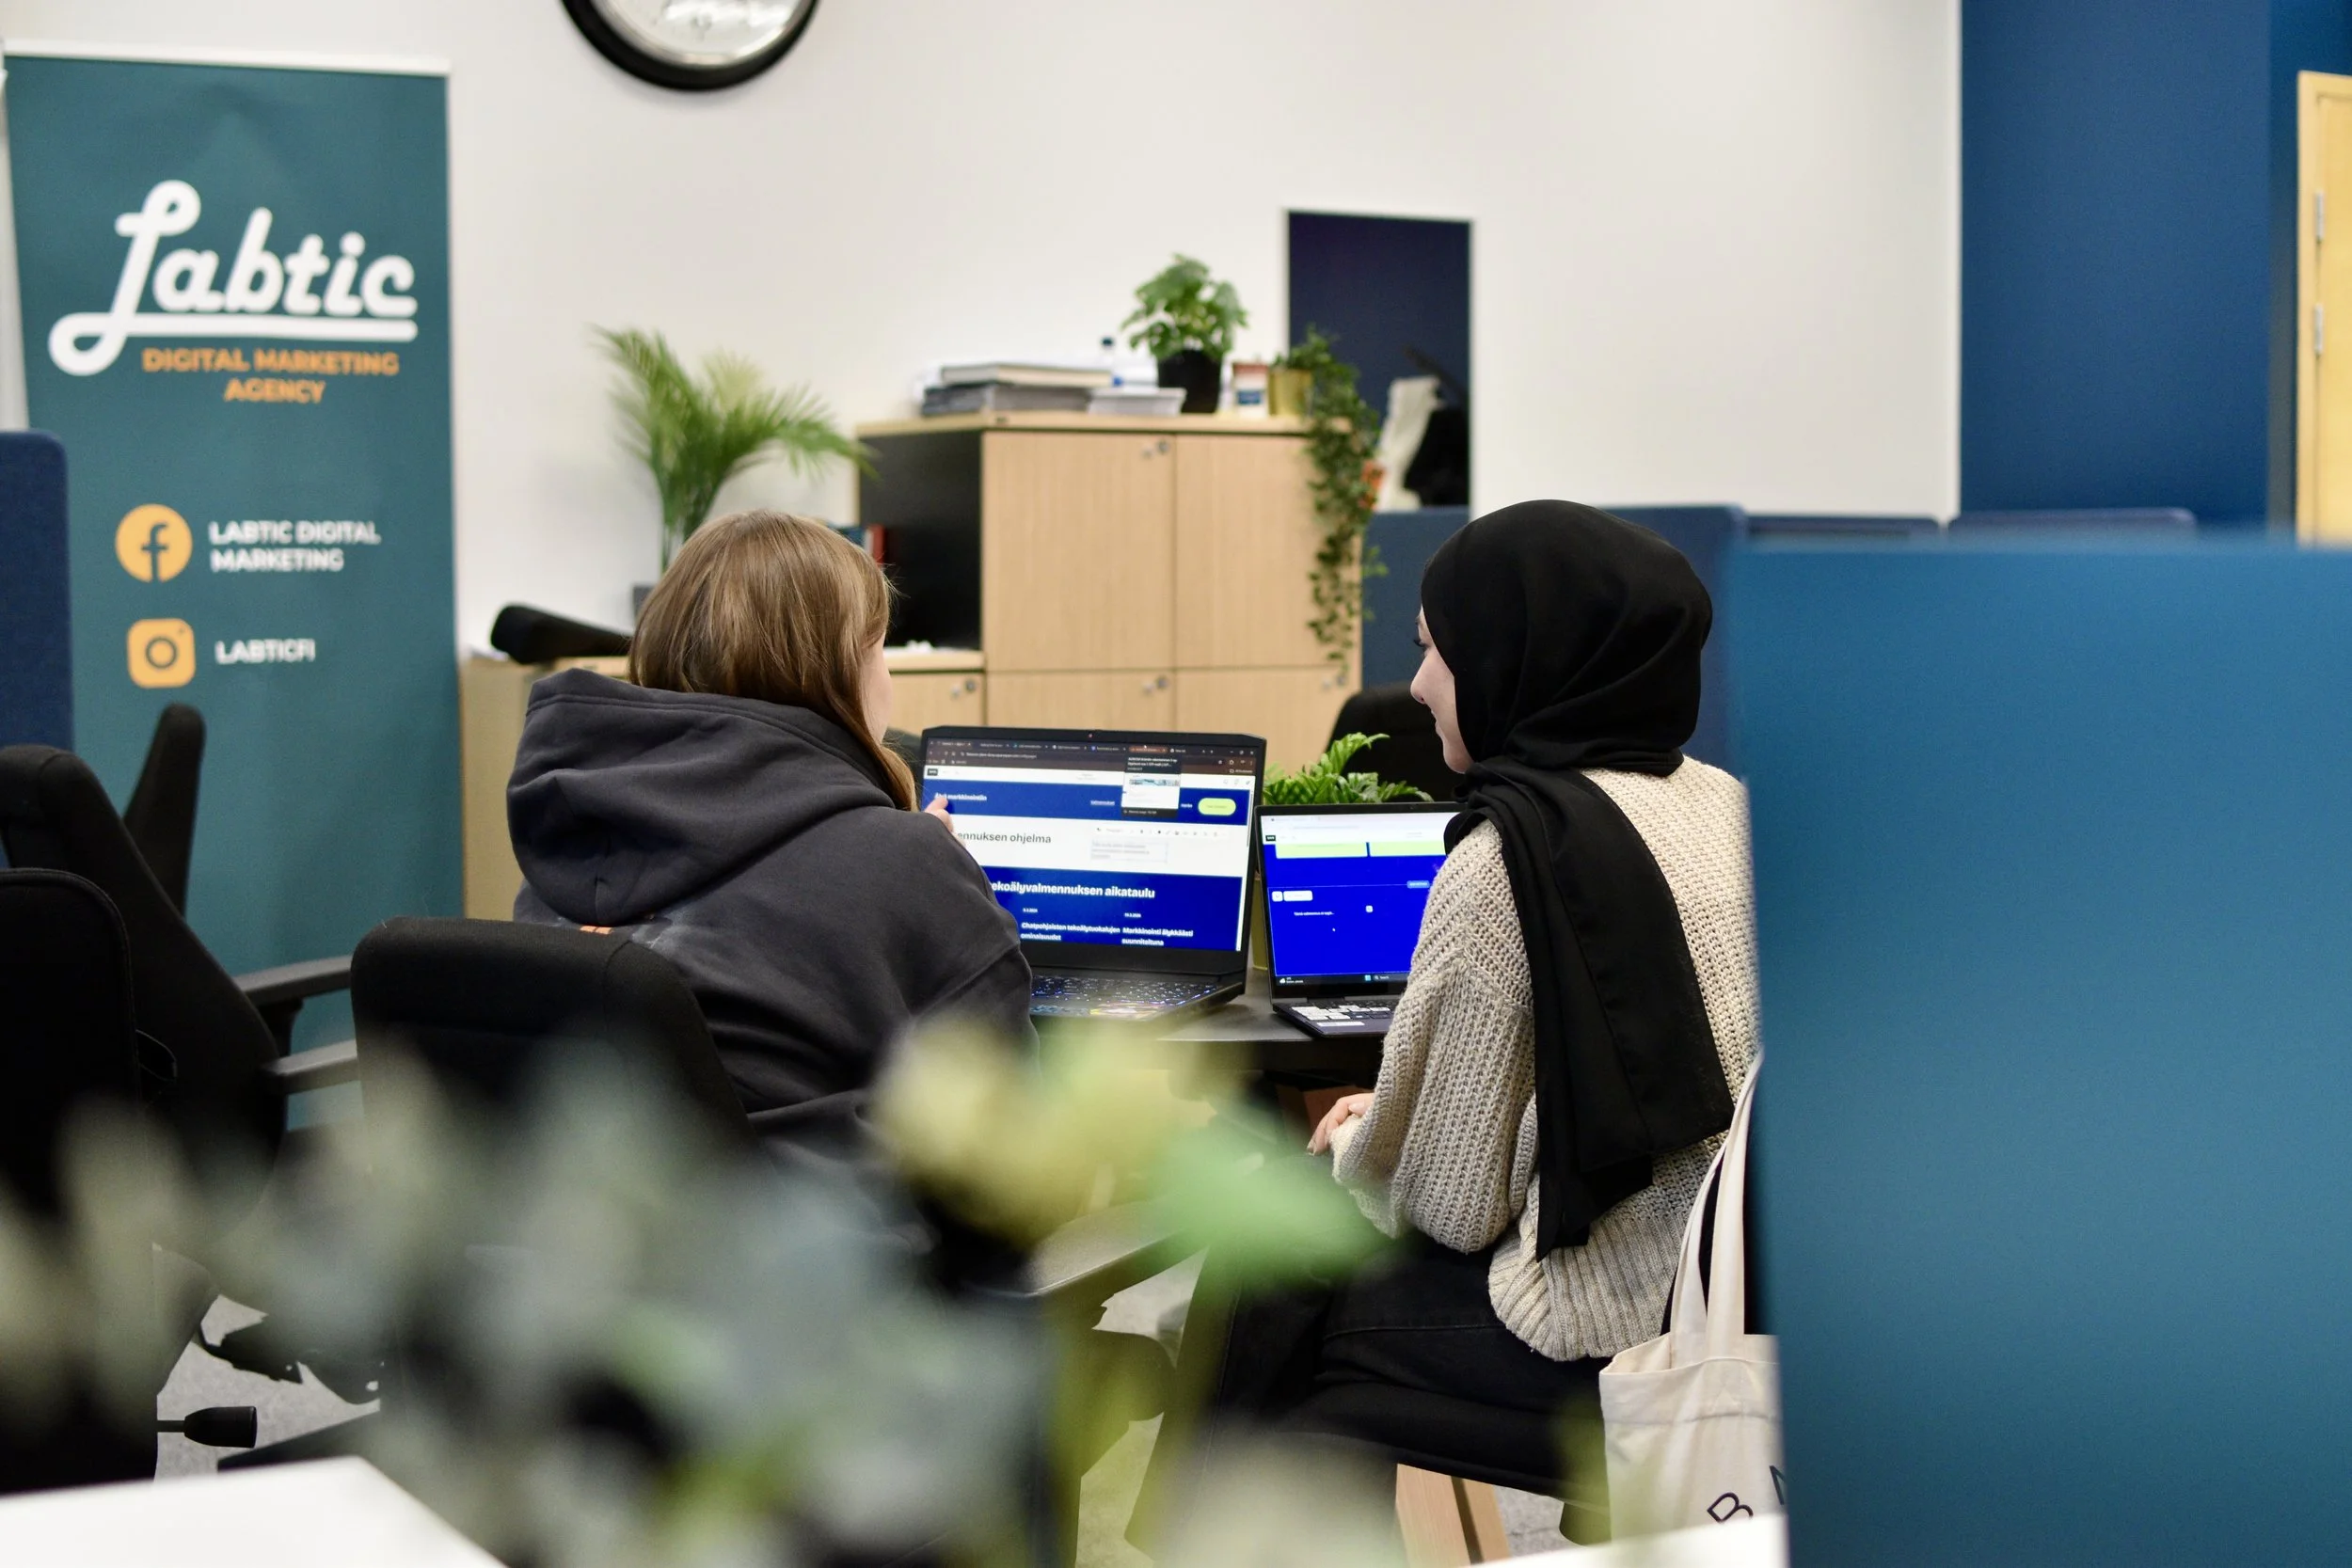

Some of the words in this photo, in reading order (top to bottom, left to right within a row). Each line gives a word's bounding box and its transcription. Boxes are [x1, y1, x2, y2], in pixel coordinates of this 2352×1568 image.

[49, 180, 418, 375] Labtic
[143, 348, 249, 372] DIGITAL
[254, 349, 400, 375] MARKETING
[223, 377, 326, 404] AGENCY
[209, 521, 293, 545] LABTIC
[295, 520, 380, 544] DIGITAL
[211, 547, 344, 572] MARKETING
[215, 639, 316, 664] LABTICFI
[958, 832, 1008, 843] ennuksen
[1009, 833, 1052, 845] ohjelma
[1104, 886, 1155, 899] aikataulu
[1020, 931, 1062, 942] ominaisuudet
[1021, 922, 1067, 932] Chatpohjaisten
[1122, 927, 1162, 936] Markkinointi
